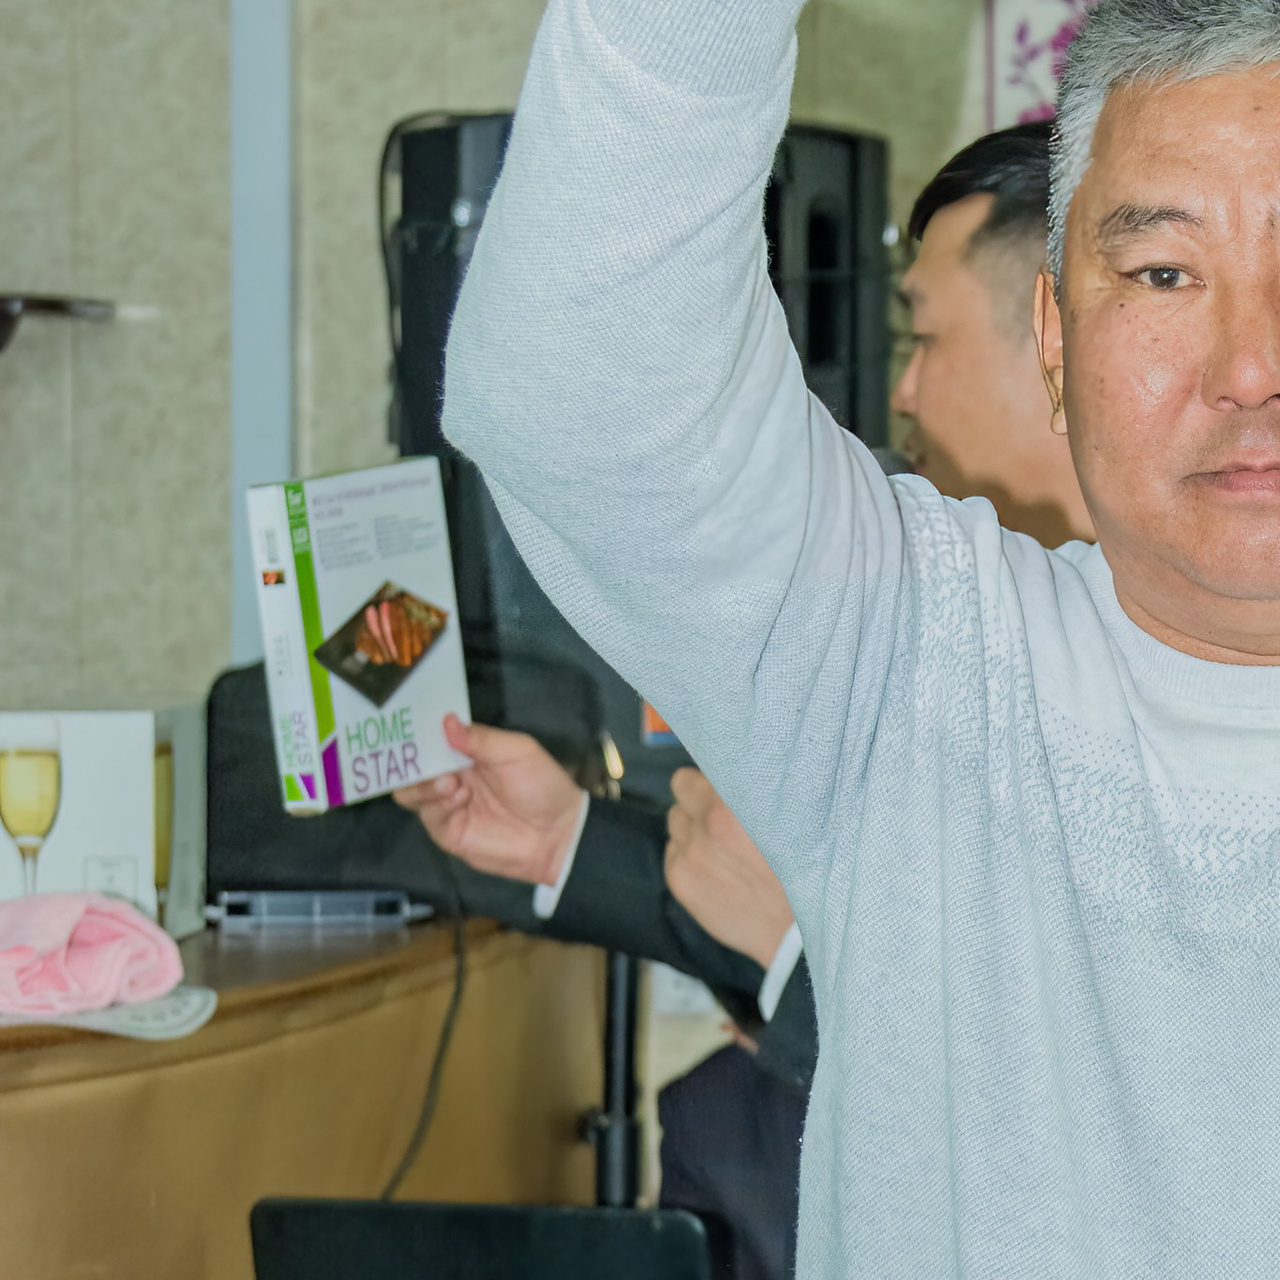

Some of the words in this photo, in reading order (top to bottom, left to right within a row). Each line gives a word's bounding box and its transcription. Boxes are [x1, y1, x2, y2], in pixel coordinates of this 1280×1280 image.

[291, 709, 314, 765] STAR
[345, 706, 414, 754] HOME
[352, 742, 421, 794] STAR
